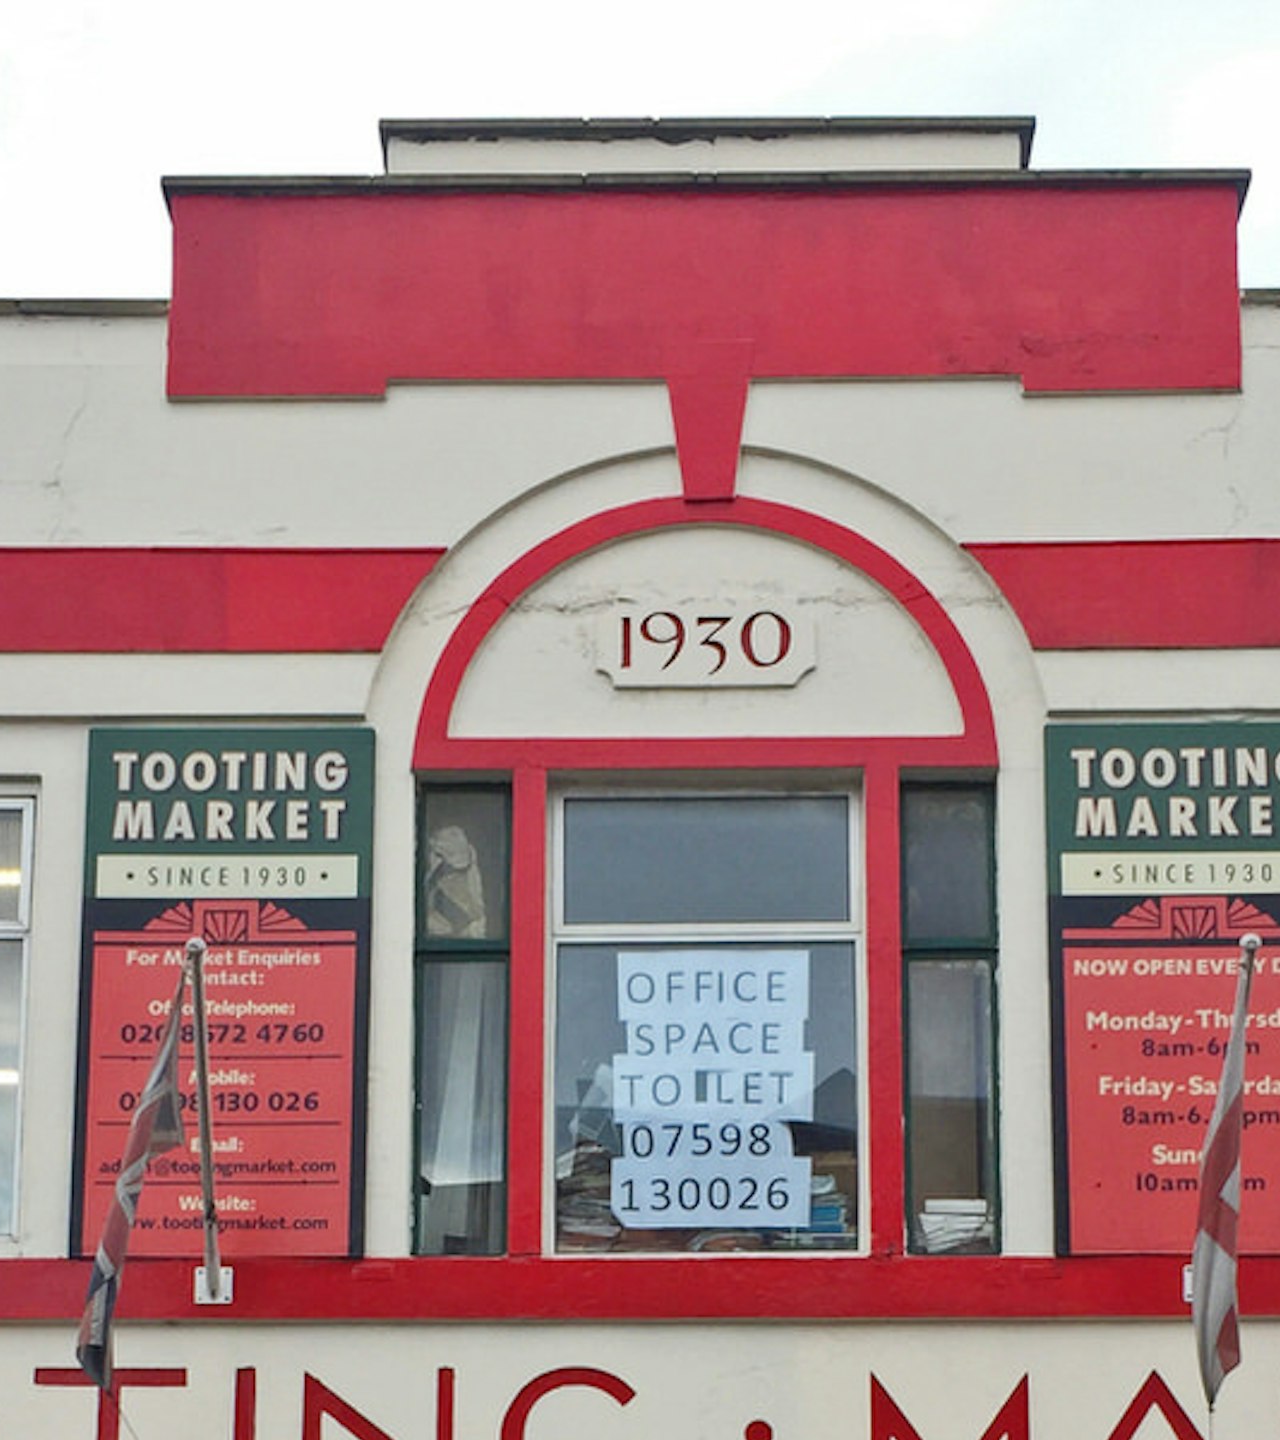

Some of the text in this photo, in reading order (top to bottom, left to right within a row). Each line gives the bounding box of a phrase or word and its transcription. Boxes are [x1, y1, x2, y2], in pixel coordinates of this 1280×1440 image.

[619, 610, 791, 675] 1930
[112, 751, 349, 792] TOOTING
[112, 800, 347, 840] MARKET
[148, 867, 306, 886] SINCE 1930
[1113, 864, 1273, 883] SINCE 1930
[126, 950, 321, 970] For Mket Enquiries
[1073, 960, 1127, 976] NOW
[1133, 959, 1192, 976] OPEN
[1196, 958, 1267, 975] EVEY
[185, 969, 264, 985] Cntact:
[626, 970, 786, 1004] OFFICE
[256, 1024, 324, 1043] 4760
[634, 1021, 780, 1056] SPACE
[620, 1070, 795, 1107] TO LET
[218, 1092, 258, 1111] 130
[268, 1092, 319, 1111] 026
[190, 1137, 244, 1153] Eail:
[631, 1123, 772, 1158] 07598
[179, 1195, 257, 1211] Wesite:
[619, 1177, 790, 1213] 130026
